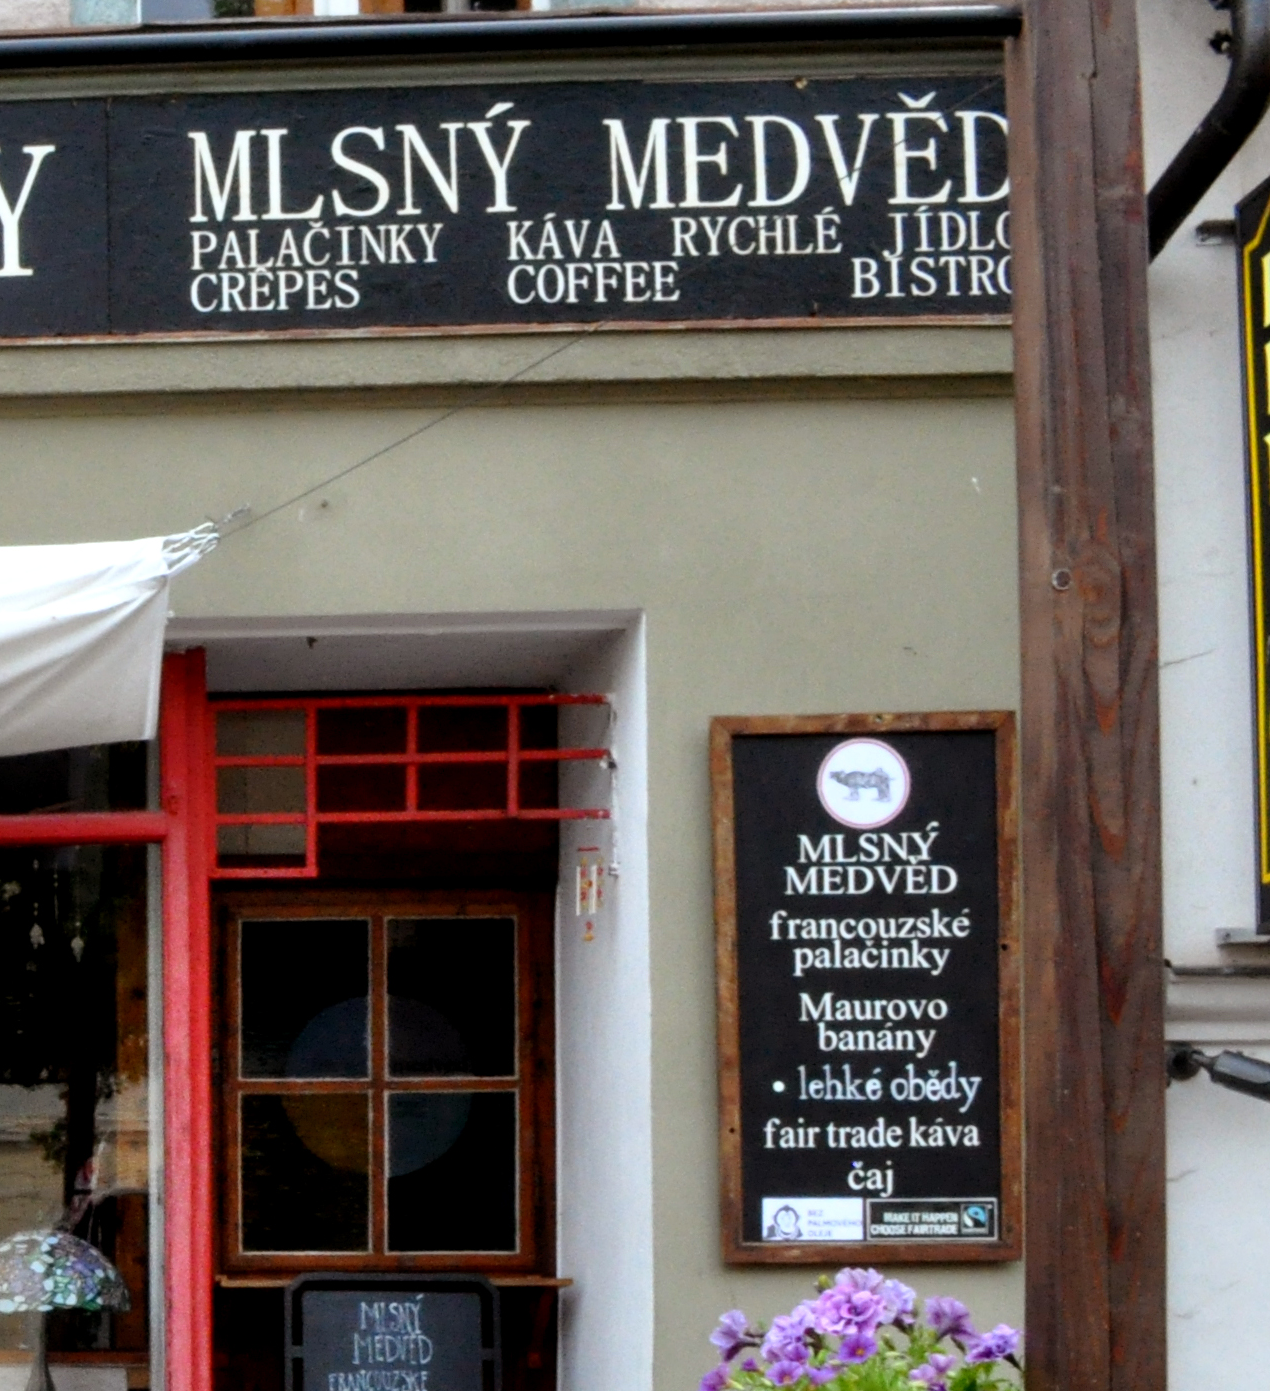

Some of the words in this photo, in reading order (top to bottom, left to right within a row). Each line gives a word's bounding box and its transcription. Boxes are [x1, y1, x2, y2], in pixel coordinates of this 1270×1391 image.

[188, 102, 531, 222] MLSNÝ
[602, 91, 1011, 210] MEDVĚD
[190, 221, 444, 270] PALAČINKY
[507, 212, 620, 261] KÁVA
[672, 207, 842, 257] RYCHLÉ
[190, 266, 360, 312] CRÊPES
[507, 260, 680, 304] COFFEE
[797, 821, 939, 864] MLSNÝ
[784, 857, 958, 895] MEDVĚD
[769, 908, 970, 940] francouzské
[792, 940, 951, 976] palačinky
[799, 992, 948, 1021] Maurovo
[817, 1022, 936, 1058] banány
[798, 1064, 882, 1100] lehké
[890, 1061, 982, 1113] obědy
[763, 1118, 819, 1149] fair
[827, 1117, 902, 1147] trade
[909, 1117, 980, 1147] káva
[847, 1161, 895, 1197] čaj
